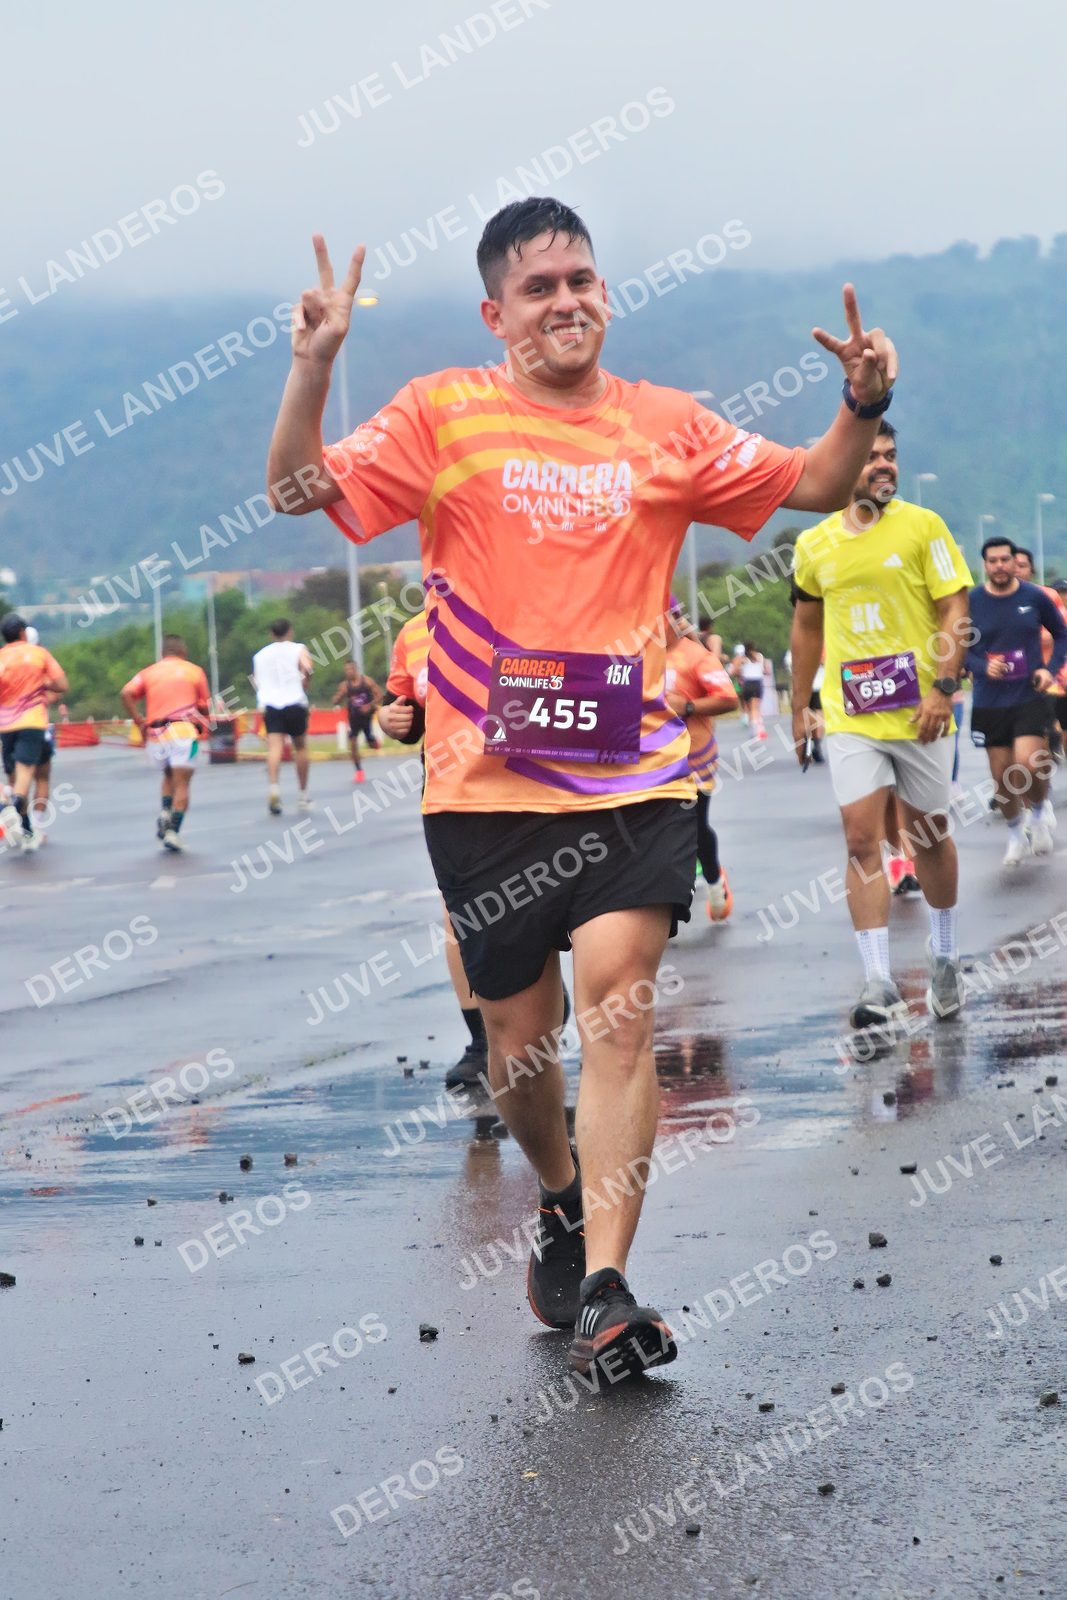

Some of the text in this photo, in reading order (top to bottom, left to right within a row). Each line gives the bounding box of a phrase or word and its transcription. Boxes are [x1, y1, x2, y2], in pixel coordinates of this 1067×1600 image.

[502, 458, 633, 495] CARRERA
[500, 657, 565, 676] CARRERA
[606, 664, 632, 685] 15K
[859, 677, 896, 700] 639
[528, 697, 599, 731] 455
